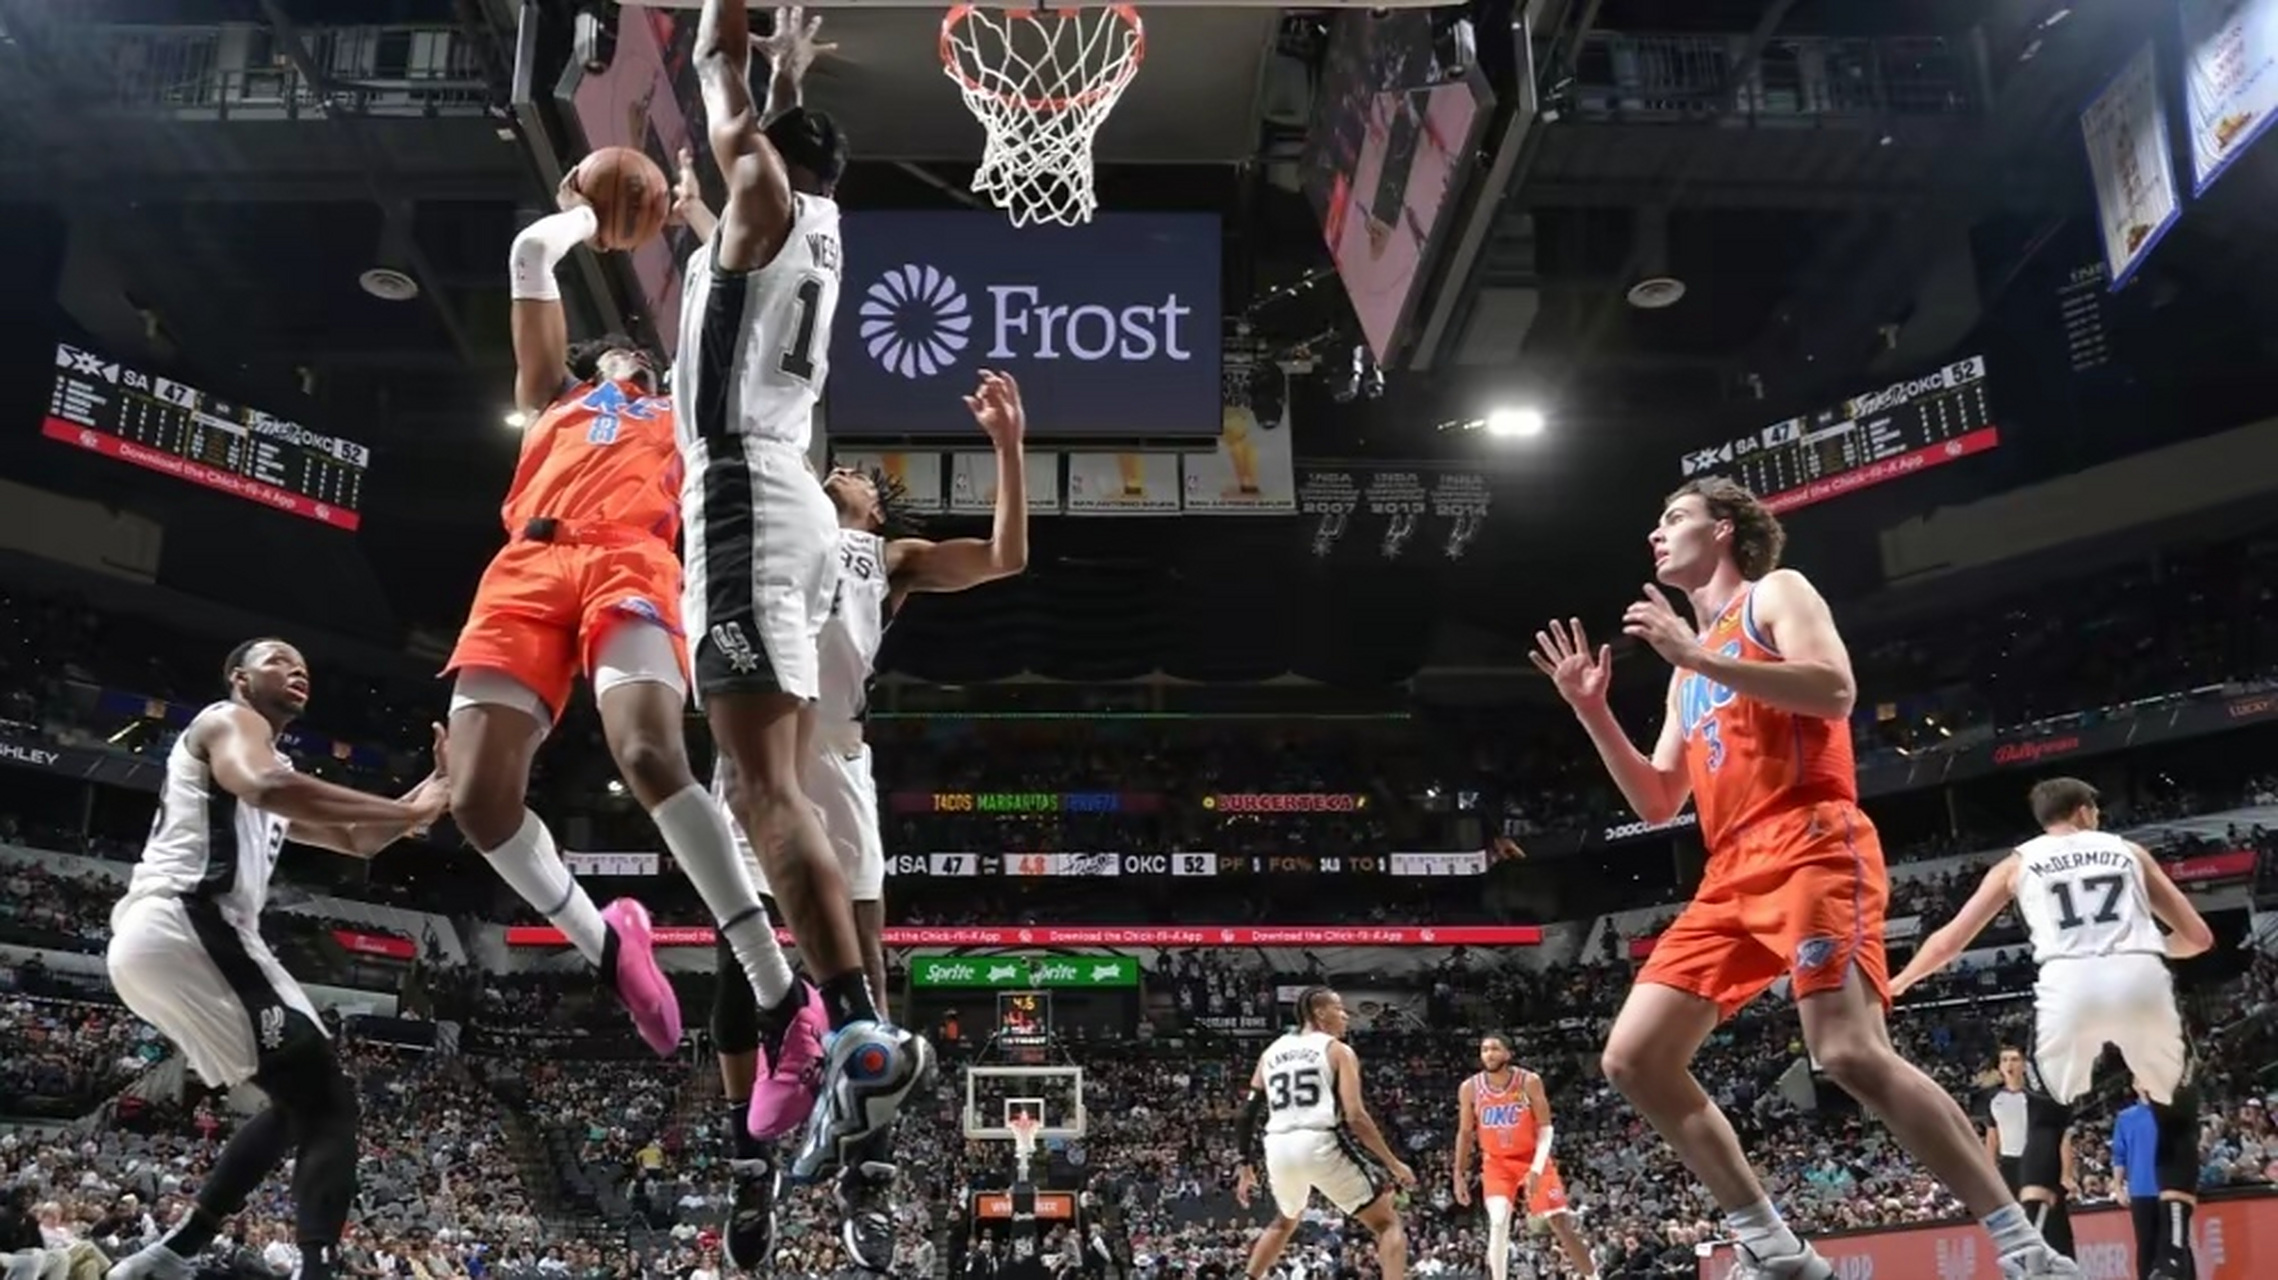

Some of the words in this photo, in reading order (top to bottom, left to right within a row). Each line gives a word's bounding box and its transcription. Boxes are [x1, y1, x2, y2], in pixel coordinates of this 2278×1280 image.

[986, 284, 1192, 362] Frost
[123, 369, 149, 391] SA
[164, 385, 187, 402] 47
[1907, 373, 1942, 396] OKC
[1952, 361, 1974, 382] 52
[301, 429, 333, 453] OKC
[341, 443, 362, 463] 52
[1735, 436, 1759, 455] SA
[1771, 424, 1790, 442] 47
[119, 443, 182, 471] Download
[184, 465, 204, 478] the
[1303, 503, 1355, 513] 2007
[1371, 503, 1426, 513] 2013
[1436, 505, 1487, 516] 2014
[1702, 717, 1726, 773] 3
[932, 793, 971, 810] TACOS
[977, 793, 1058, 811] MARGARITAS
[900, 856, 927, 873] SA
[942, 857, 962, 872] 47
[1125, 856, 1165, 873] OKC
[1184, 857, 1204, 873] 52
[1220, 858, 1243, 870] PF
[1269, 857, 1312, 871] FG%
[1349, 858, 1373, 871] TO
[2029, 851, 2132, 876] McDERMOTT
[2051, 875, 2122, 929] 17
[980, 929, 1000, 944] App
[1050, 928, 1103, 943] Download
[1106, 929, 1124, 941] the
[1184, 929, 1203, 944] App
[1252, 928, 1304, 943] Download
[1306, 929, 1323, 941] the
[1383, 929, 1403, 944] App
[925, 963, 975, 982] Sprite
[1269, 1069, 1321, 1112] 35
[1480, 1104, 1524, 1128] OKC
